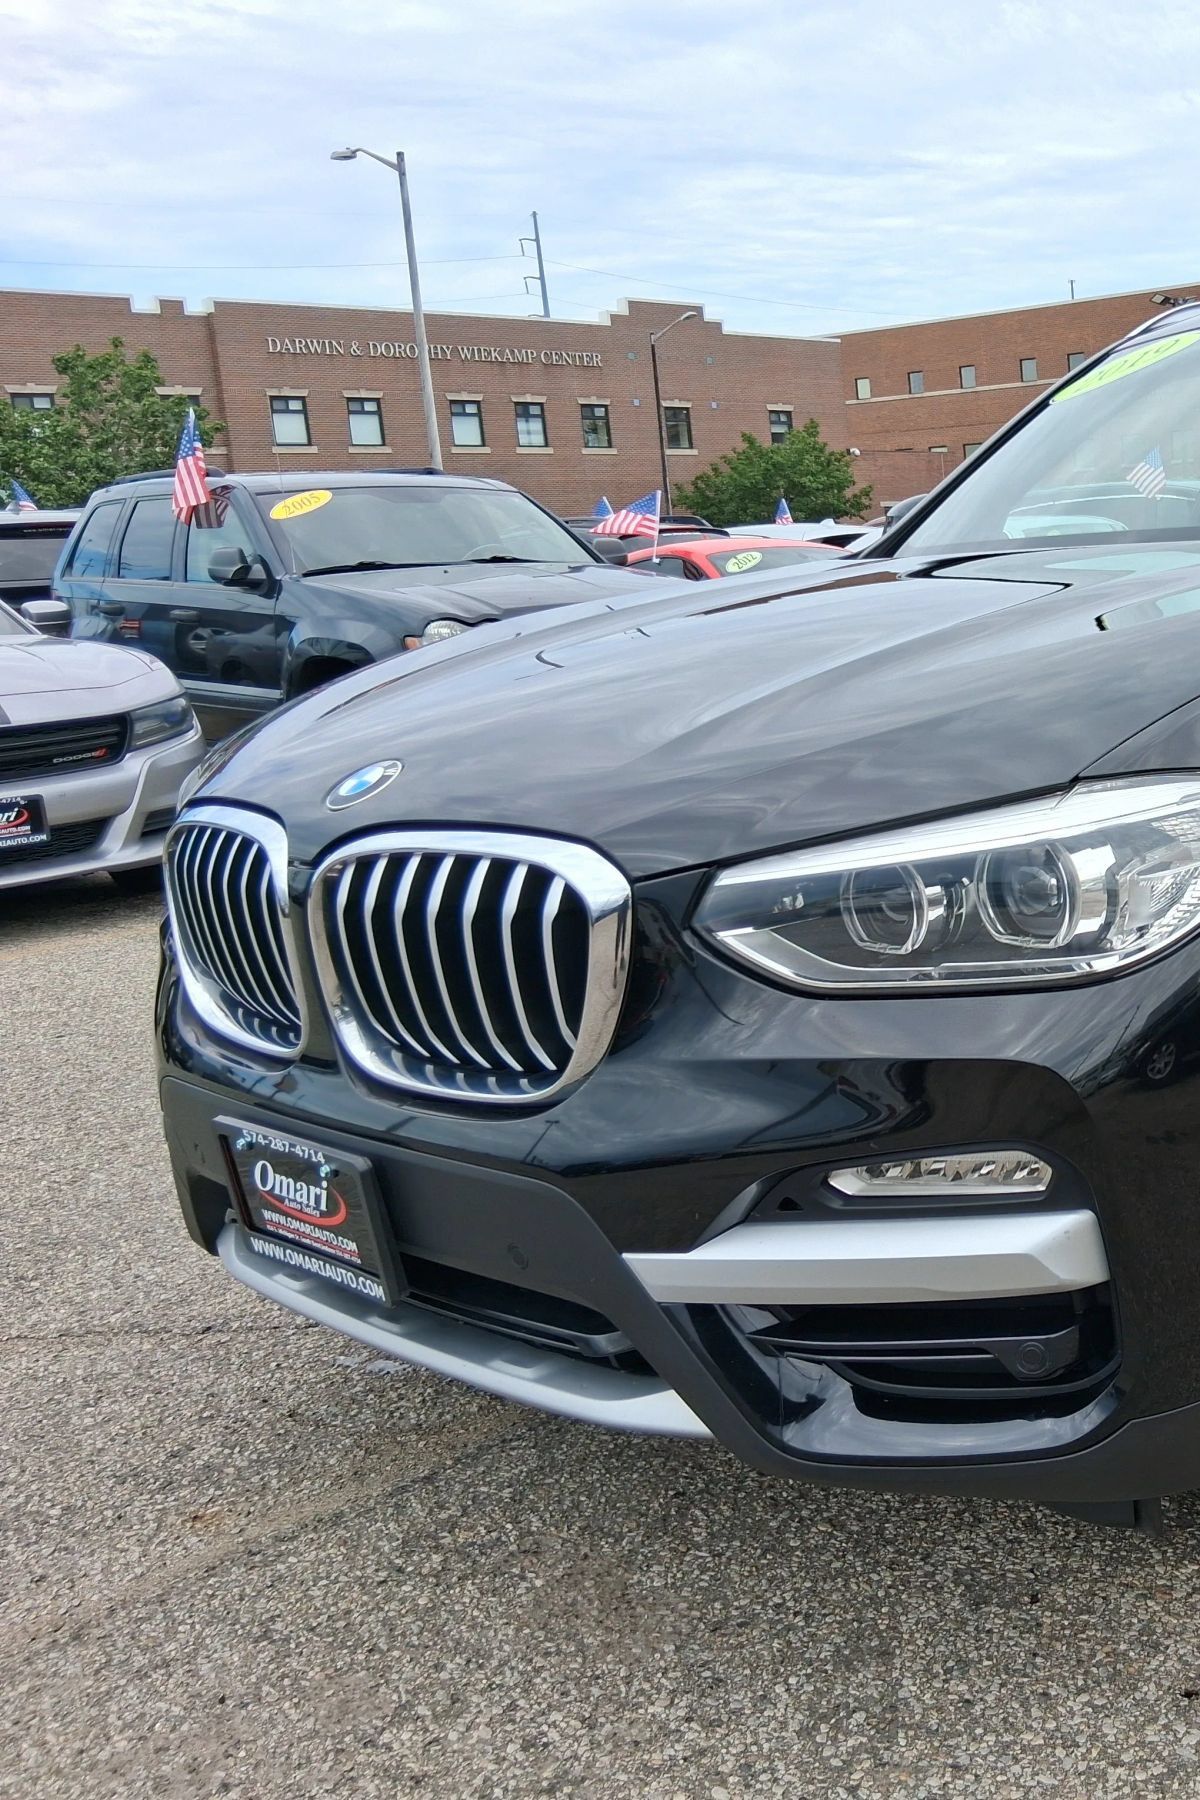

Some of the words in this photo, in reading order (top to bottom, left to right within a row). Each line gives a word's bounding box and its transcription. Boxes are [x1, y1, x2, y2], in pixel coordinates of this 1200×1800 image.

[267, 337, 345, 356] DARWIN
[350, 341, 363, 357] &
[369, 341, 452, 361] DOROHY
[457, 345, 537, 364] WIEKAMP
[540, 350, 603, 367] CENTER
[282, 493, 320, 516] 2005
[732, 553, 758, 570] 2012
[53, 751, 97, 764] DODGE
[242, 1129, 326, 1164] 574-287-4714
[255, 1160, 328, 1211] Omari
[284, 1198, 302, 1211] Auto
[302, 1203, 320, 1218] Sales
[261, 1208, 359, 1254] WWW.OMARIAUTO.COM
[250, 1237, 387, 1302] WWW.OMARIAUTO.COM
